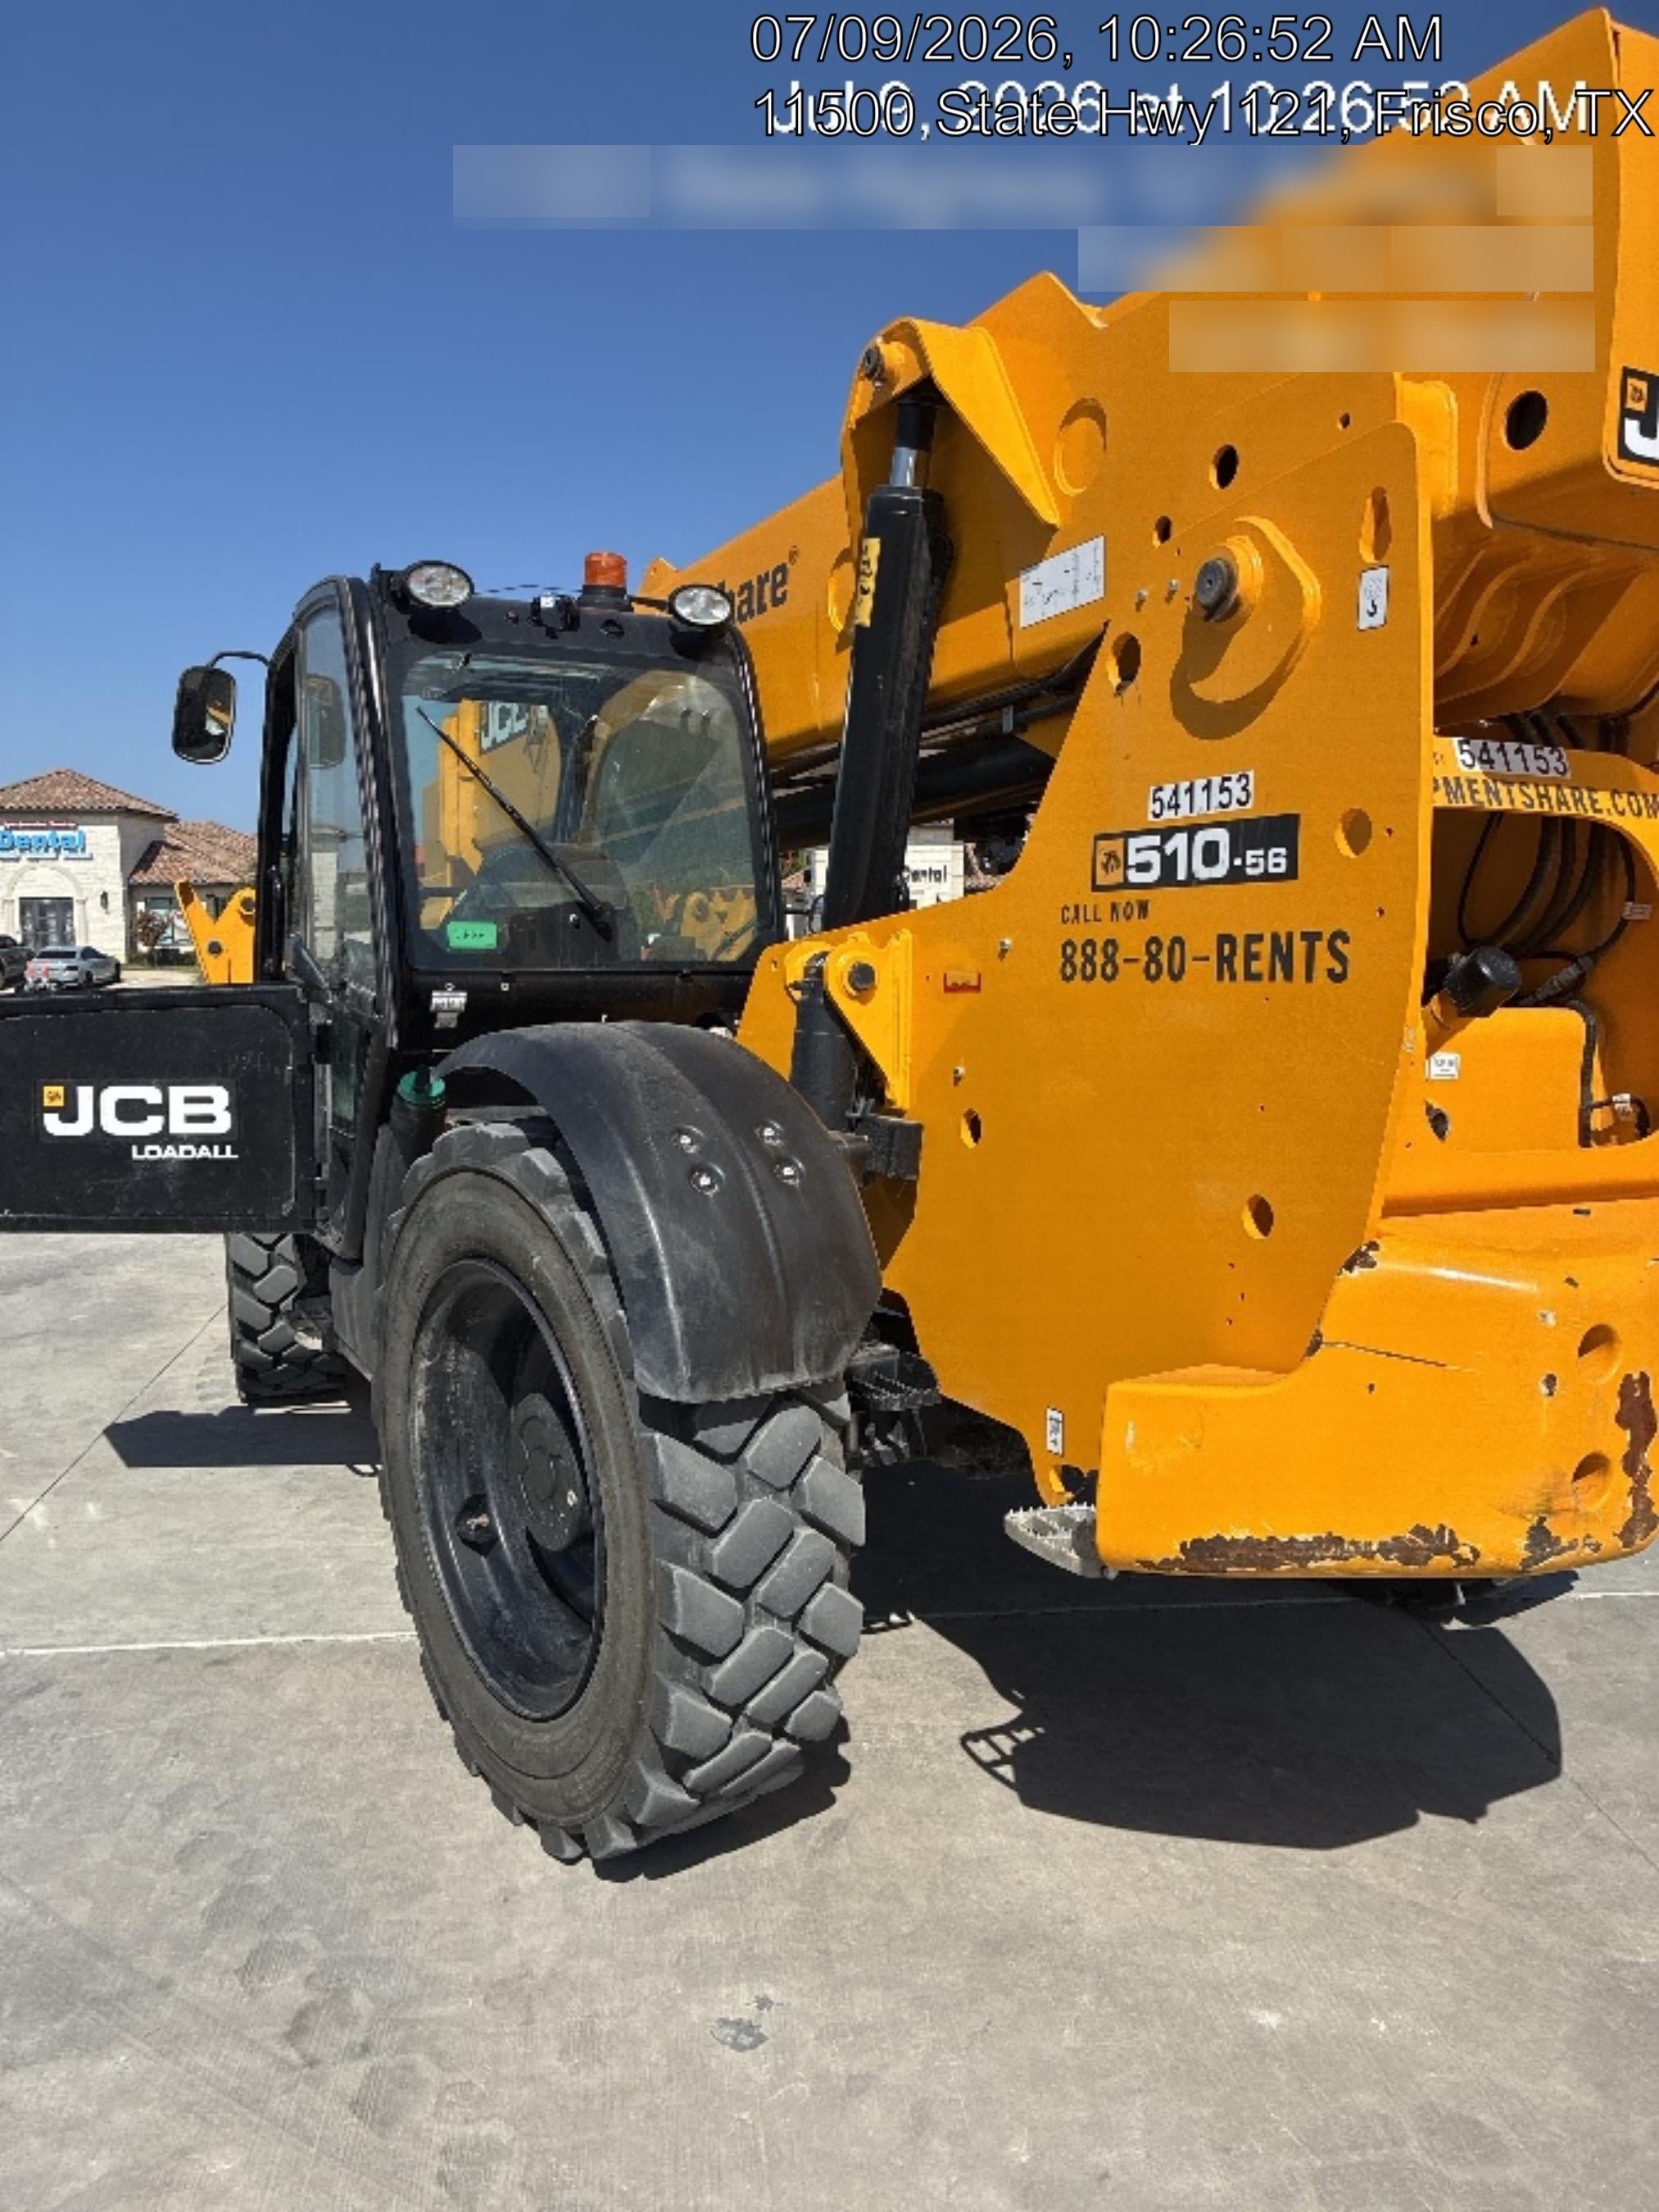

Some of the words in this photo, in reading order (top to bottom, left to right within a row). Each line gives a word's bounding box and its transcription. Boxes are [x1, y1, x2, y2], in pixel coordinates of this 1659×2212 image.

[1457, 739, 1568, 777] 541153
[1151, 773, 1252, 818] 541153
[0, 829, 86, 851] Dental
[1061, 904, 1102, 925] CALL
[1110, 900, 1149, 922] NOW
[1060, 929, 1351, 983] 888-80-RENTS
[43, 1086, 232, 1136] JCB
[131, 1145, 239, 1160] LOADALL
